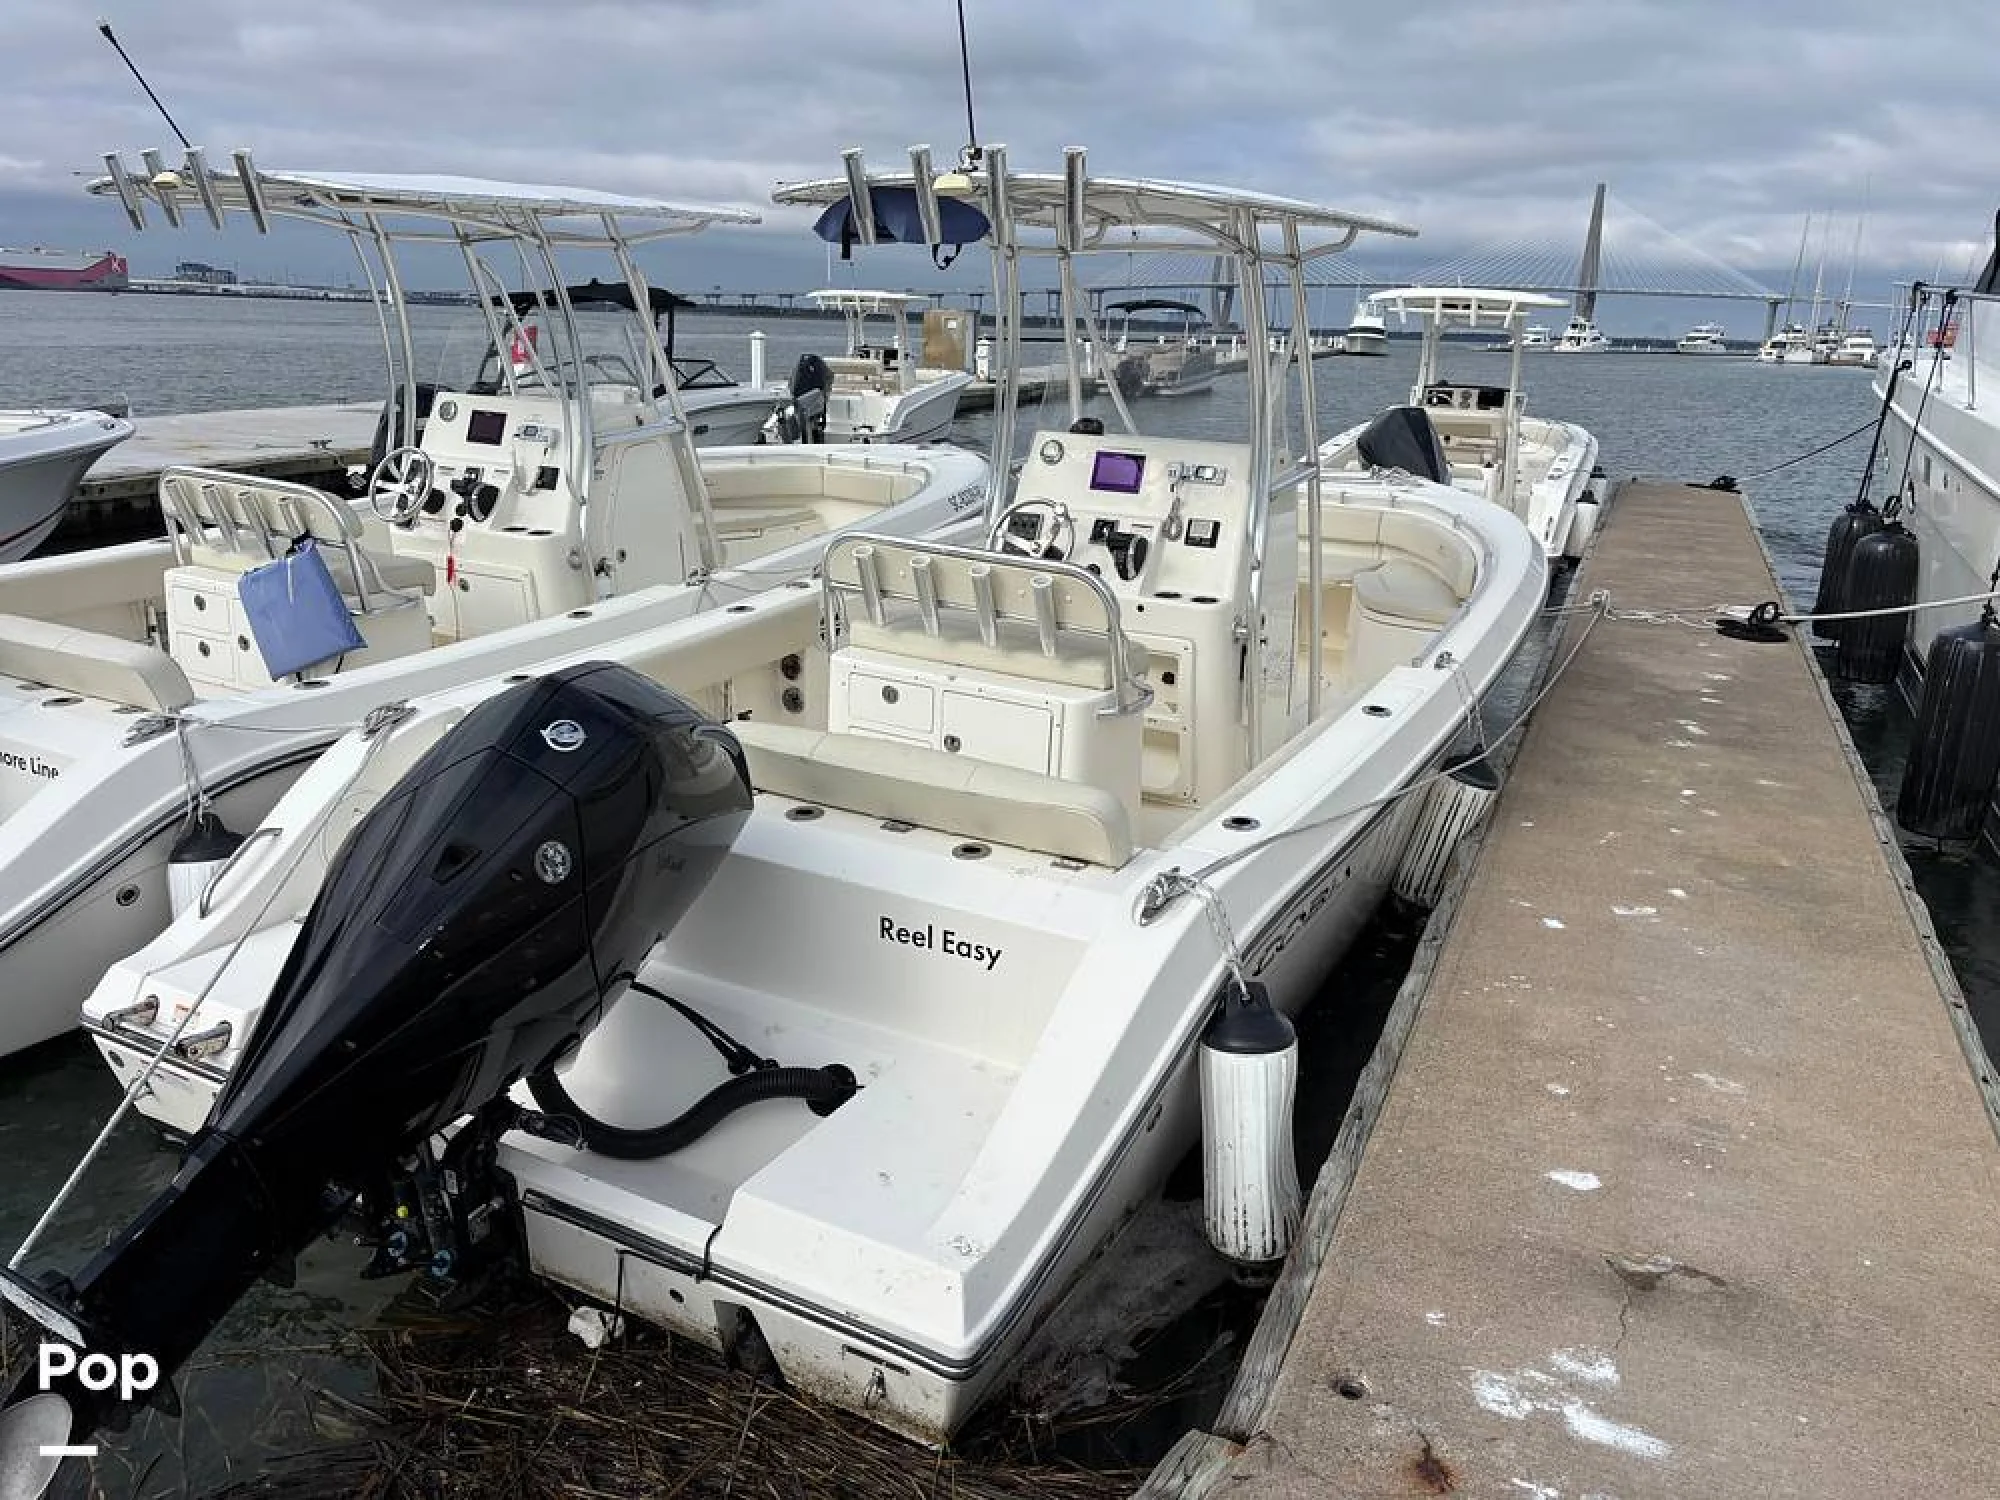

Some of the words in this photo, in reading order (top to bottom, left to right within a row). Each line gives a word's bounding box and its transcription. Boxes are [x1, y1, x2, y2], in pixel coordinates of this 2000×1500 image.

[0, 751, 27, 770] ore
[879, 915, 933, 949] Reel
[943, 929, 1002, 971] Easy
